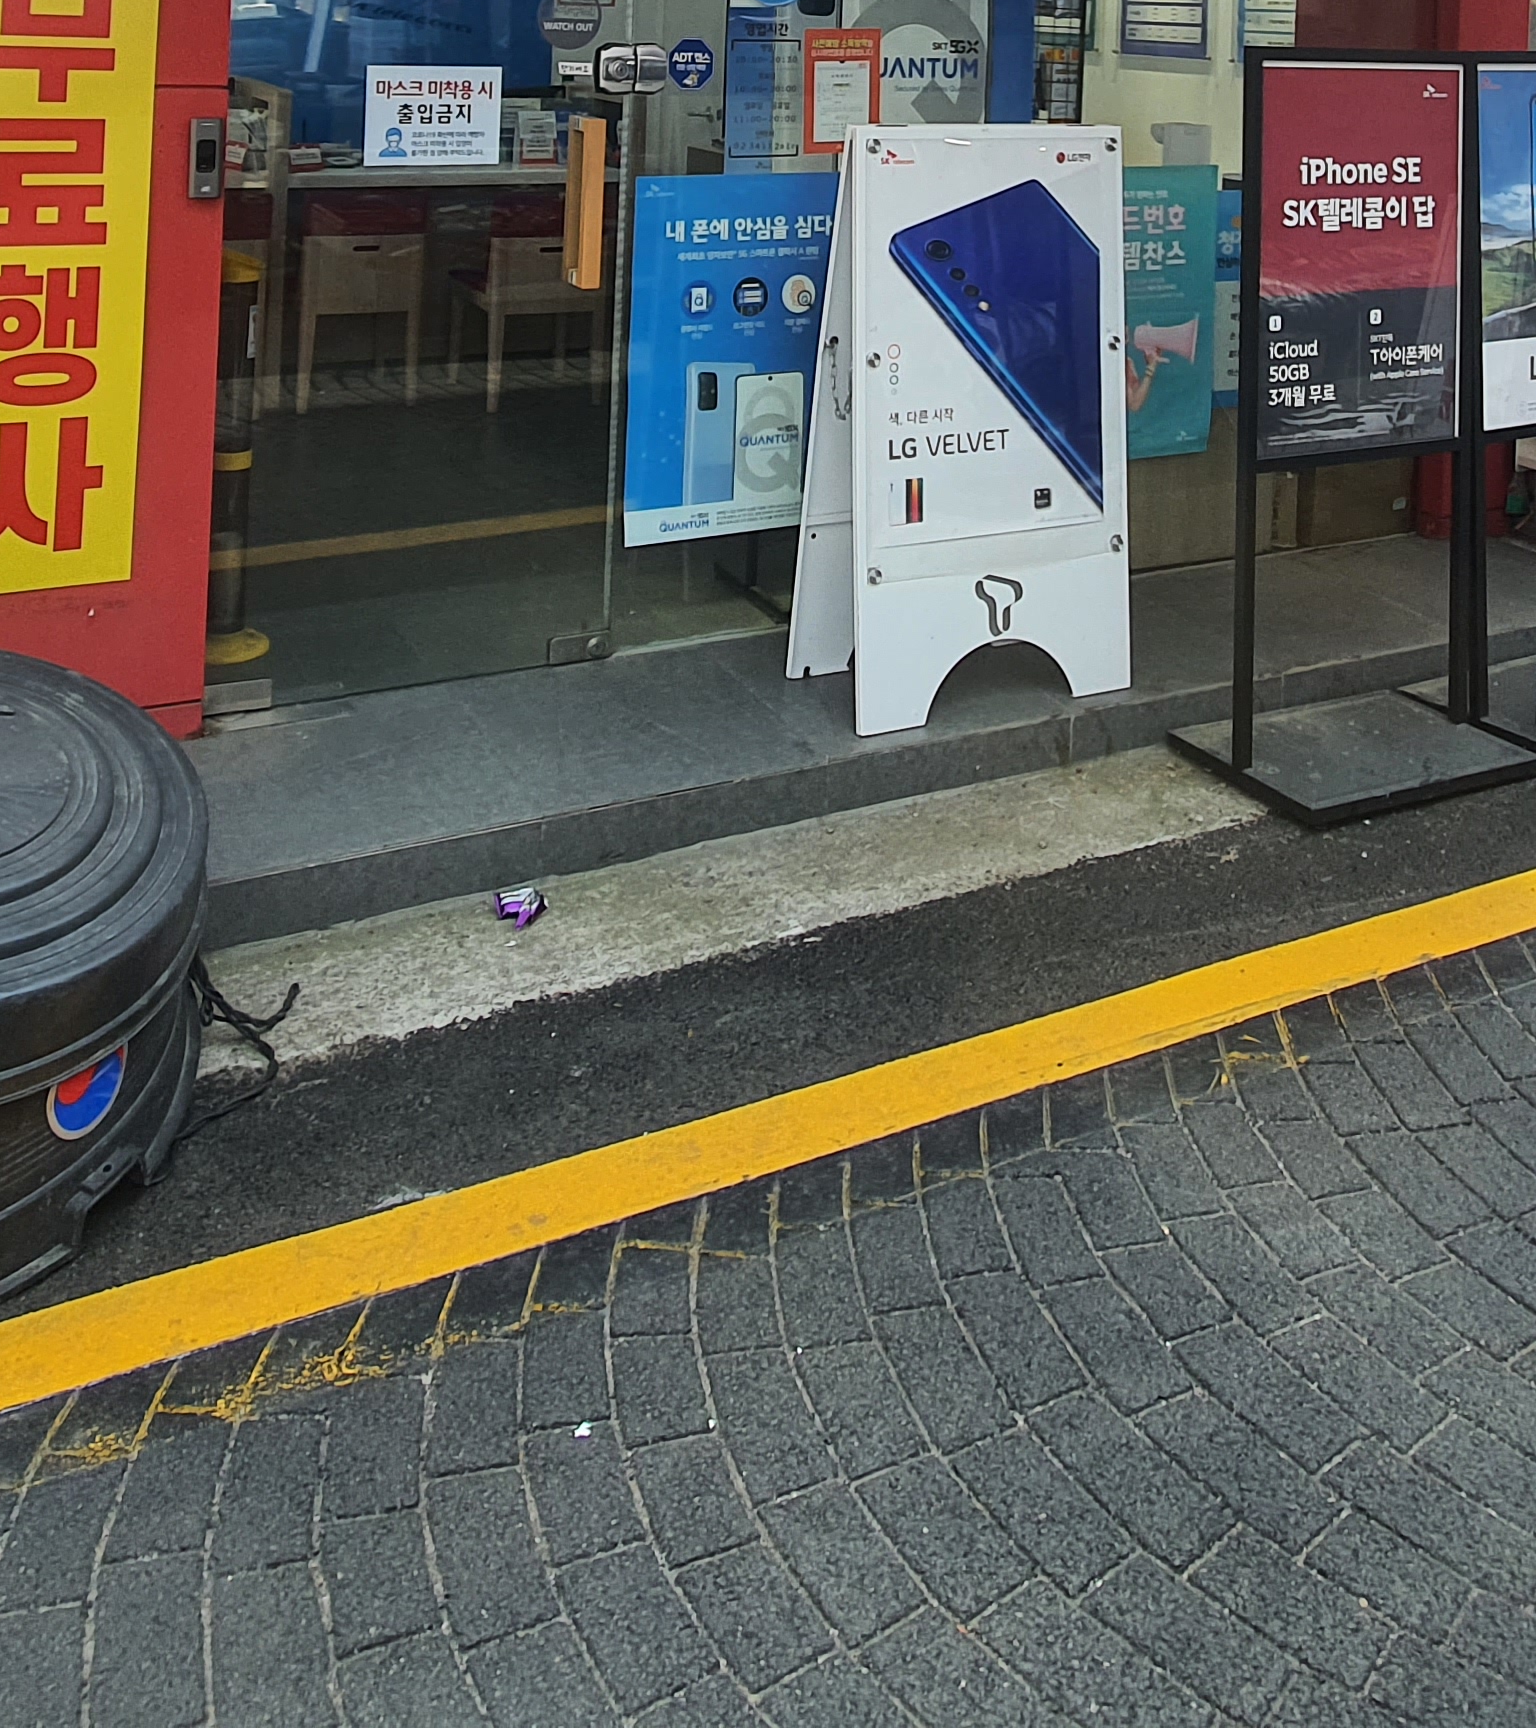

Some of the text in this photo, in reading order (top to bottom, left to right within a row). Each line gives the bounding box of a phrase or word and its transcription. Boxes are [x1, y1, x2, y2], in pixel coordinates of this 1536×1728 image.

[543, 22, 594, 32] WATCH OUT
[672, 52, 693, 63] ADT
[376, 80, 493, 100] 마스크 미착용 시
[396, 103, 472, 124] 출입금지
[1300, 156, 1422, 185] iPhone SE
[1282, 195, 1436, 232] SK텔레콤이 답
[666, 215, 833, 243] 내 폰에 안심을 심다
[1269, 339, 1318, 360] iCloud
[1370, 344, 1443, 366] T아이폰케어
[1268, 364, 1310, 383] 50GB
[1268, 384, 1336, 407] 3개월 무료
[906, 407, 954, 424] 다른 시작
[739, 433, 799, 448] QUANTUM
[888, 428, 1010, 460] LG VELVET
[659, 520, 709, 533] QUANTUM
